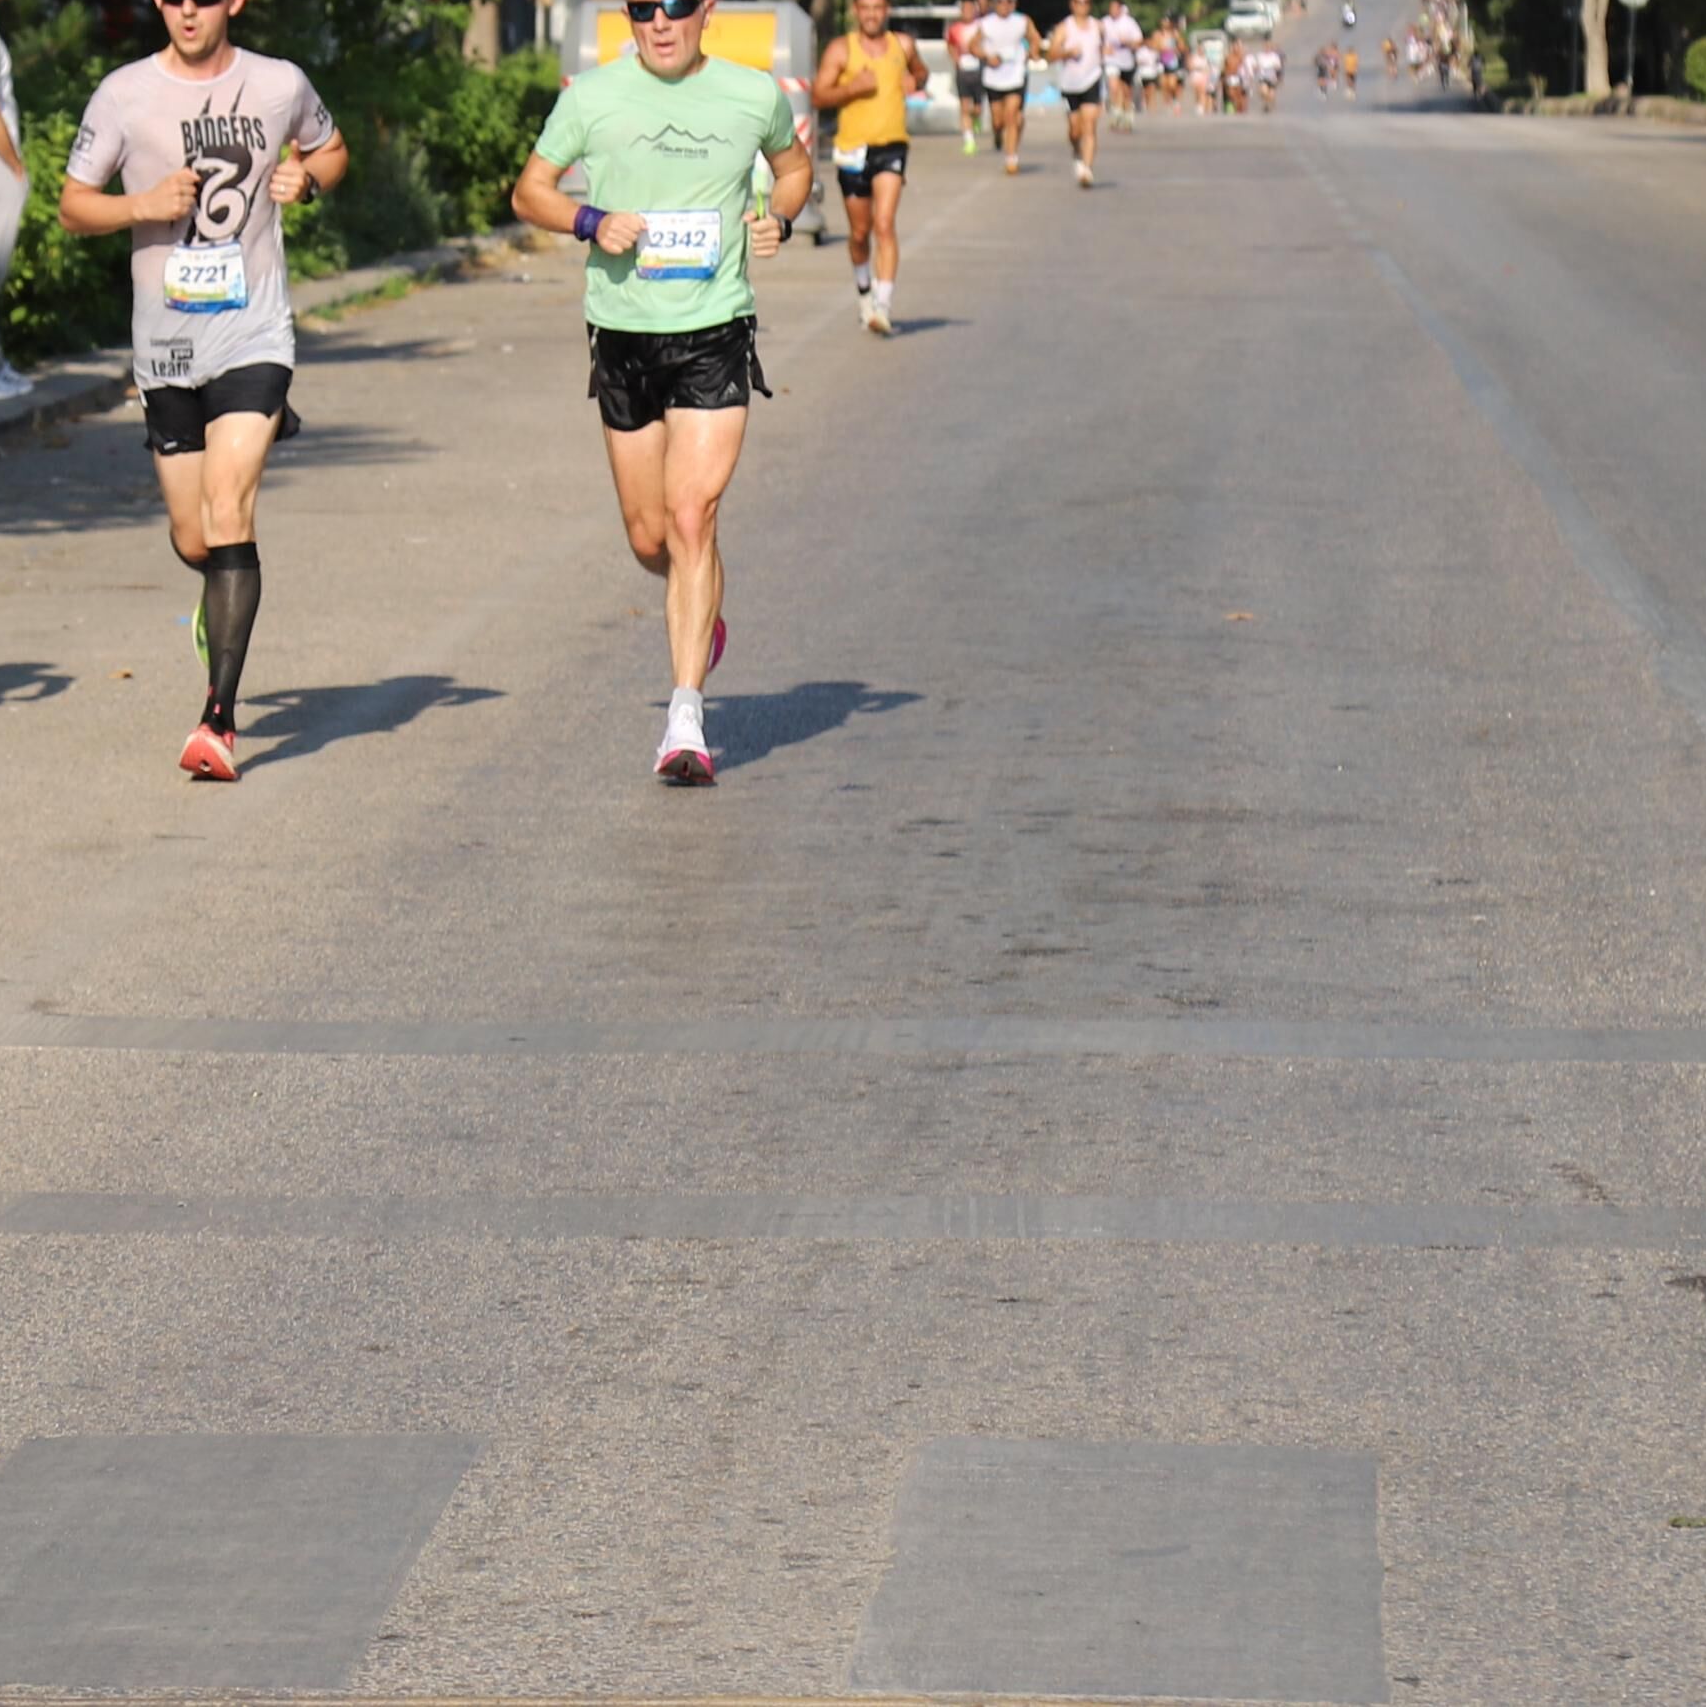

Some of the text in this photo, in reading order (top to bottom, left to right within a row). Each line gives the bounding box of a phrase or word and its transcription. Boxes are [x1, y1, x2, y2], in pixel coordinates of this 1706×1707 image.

[181, 114, 267, 154] BADGERS
[649, 230, 708, 249] 2342
[178, 264, 227, 283] 2721
